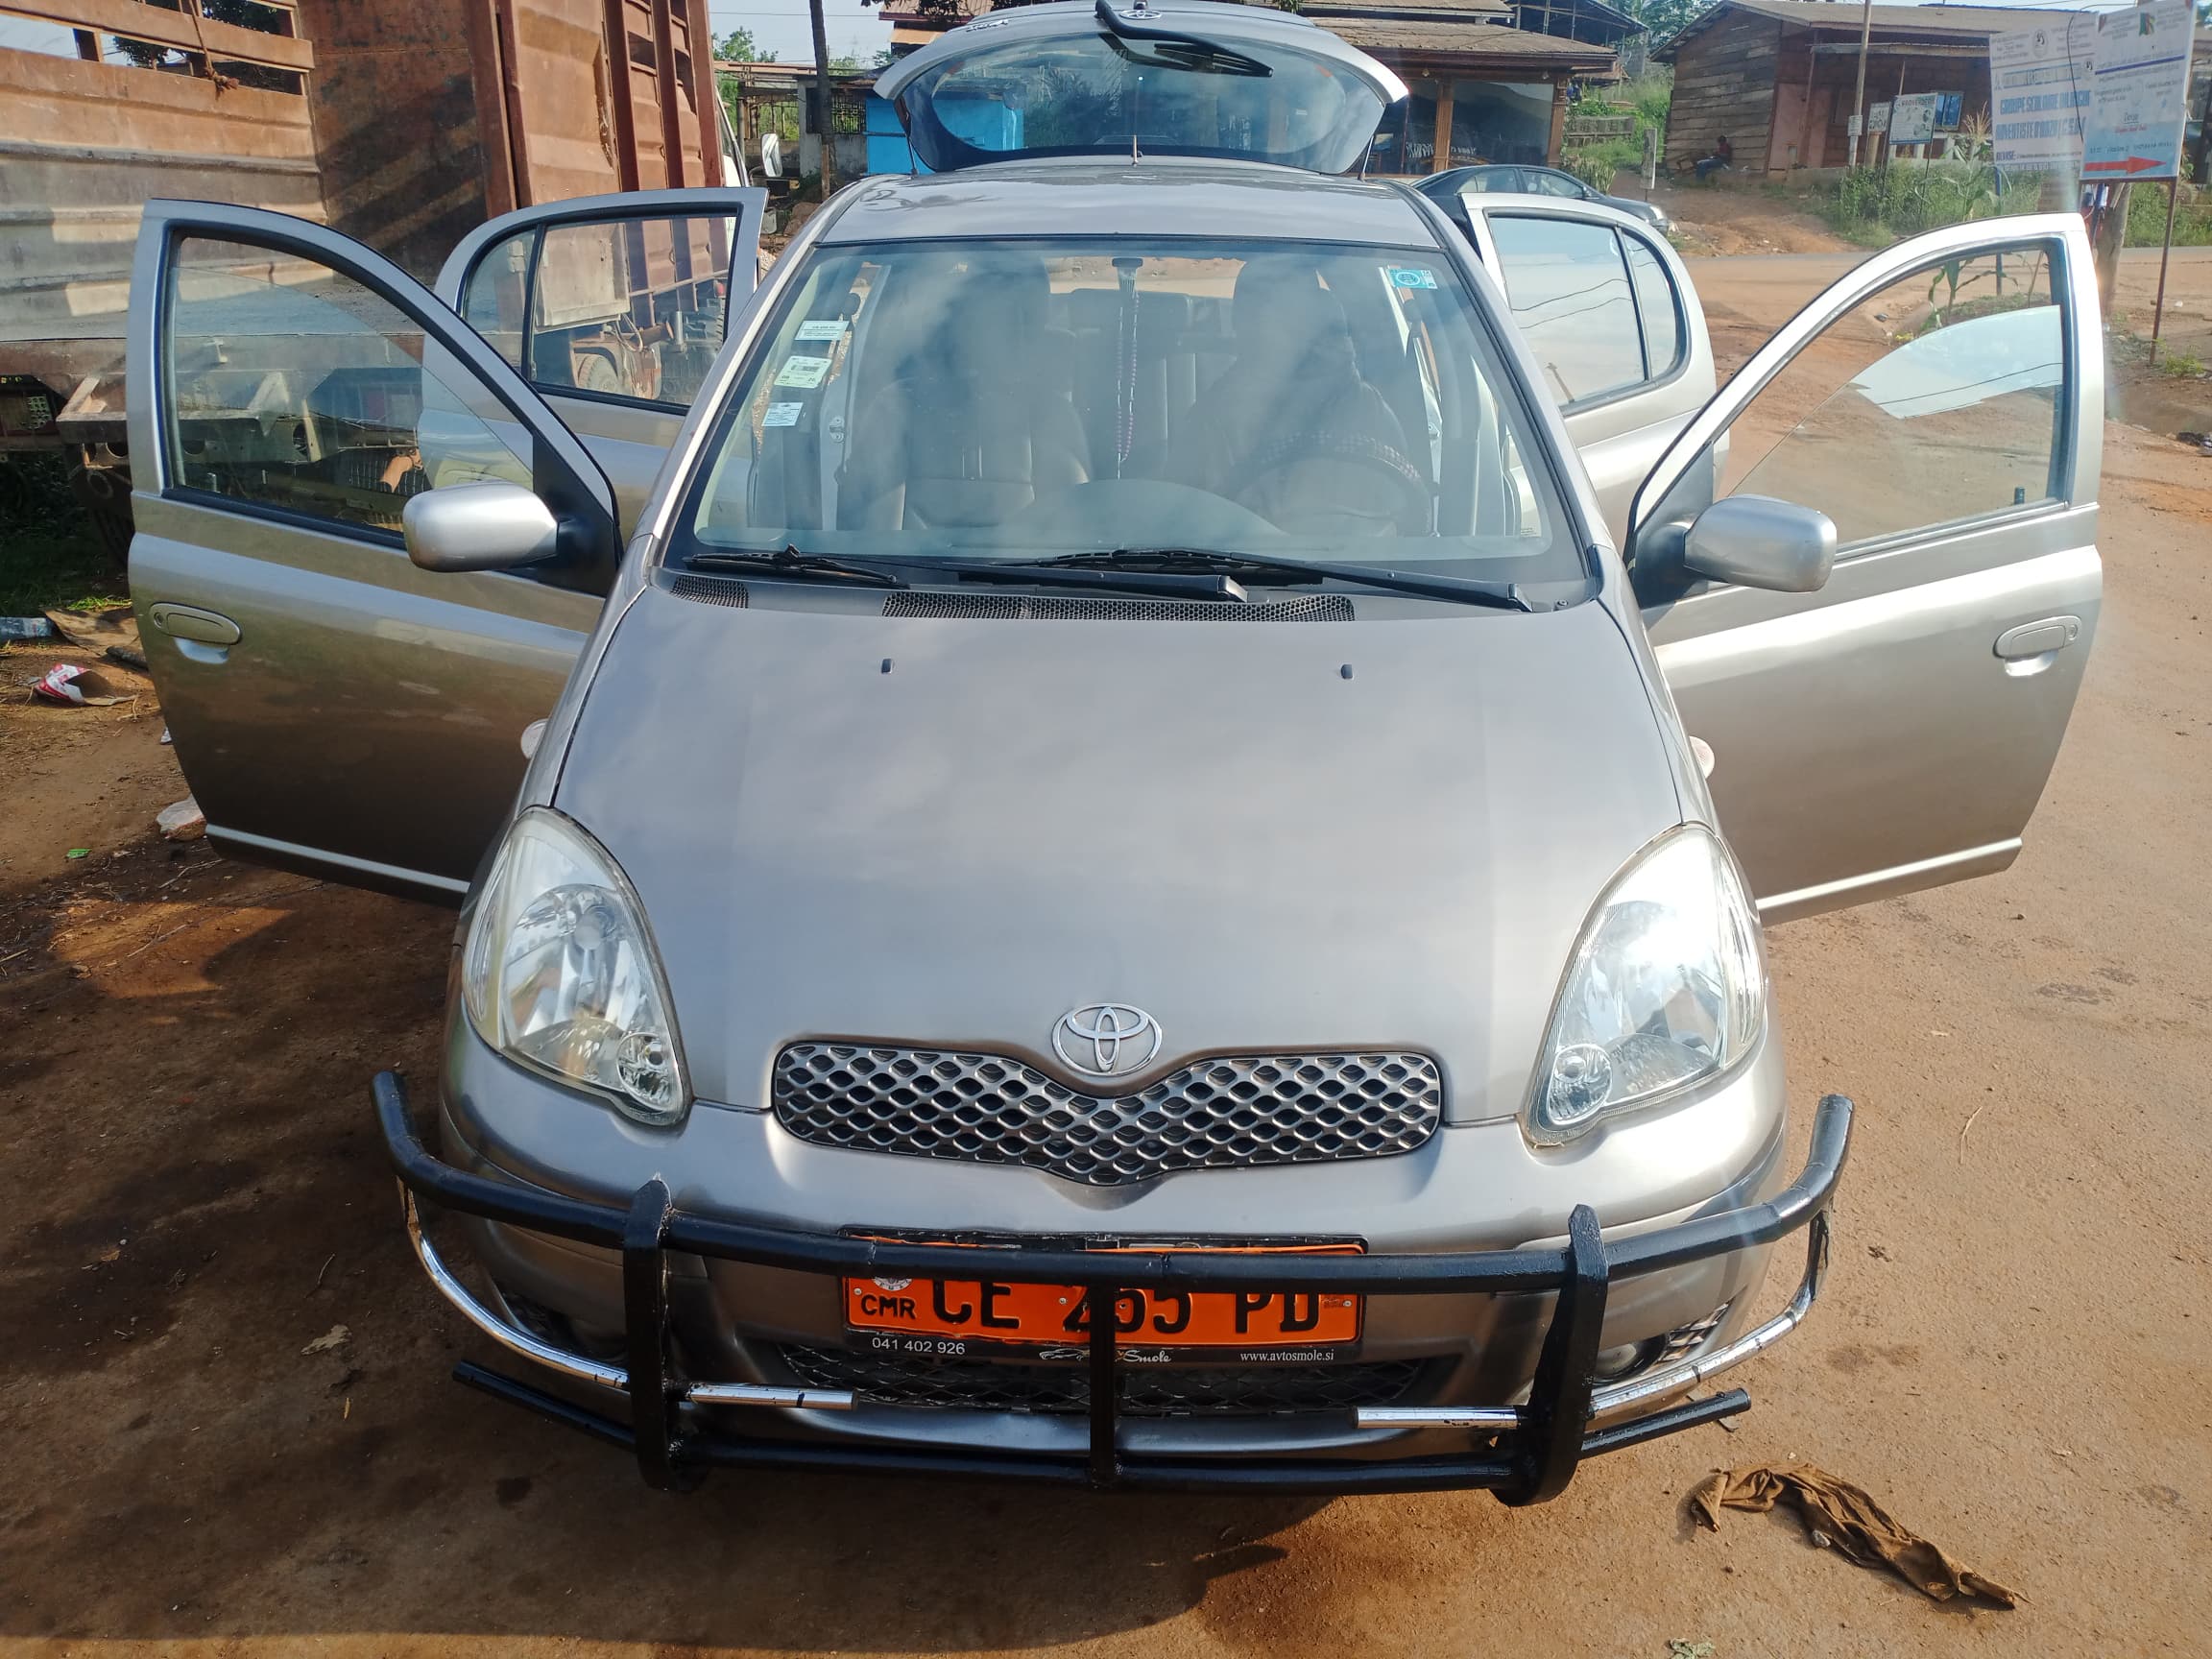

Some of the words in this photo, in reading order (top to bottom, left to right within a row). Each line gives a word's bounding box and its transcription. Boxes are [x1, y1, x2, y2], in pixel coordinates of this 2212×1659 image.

[861, 1294, 916, 1319] CMR
[933, 1280, 1021, 1330] CE
[872, 1336, 900, 1351] 041
[903, 1339, 933, 1354] 402
[937, 1341, 966, 1356] 926
[1239, 1349, 1334, 1361] www.avtosmole.si
